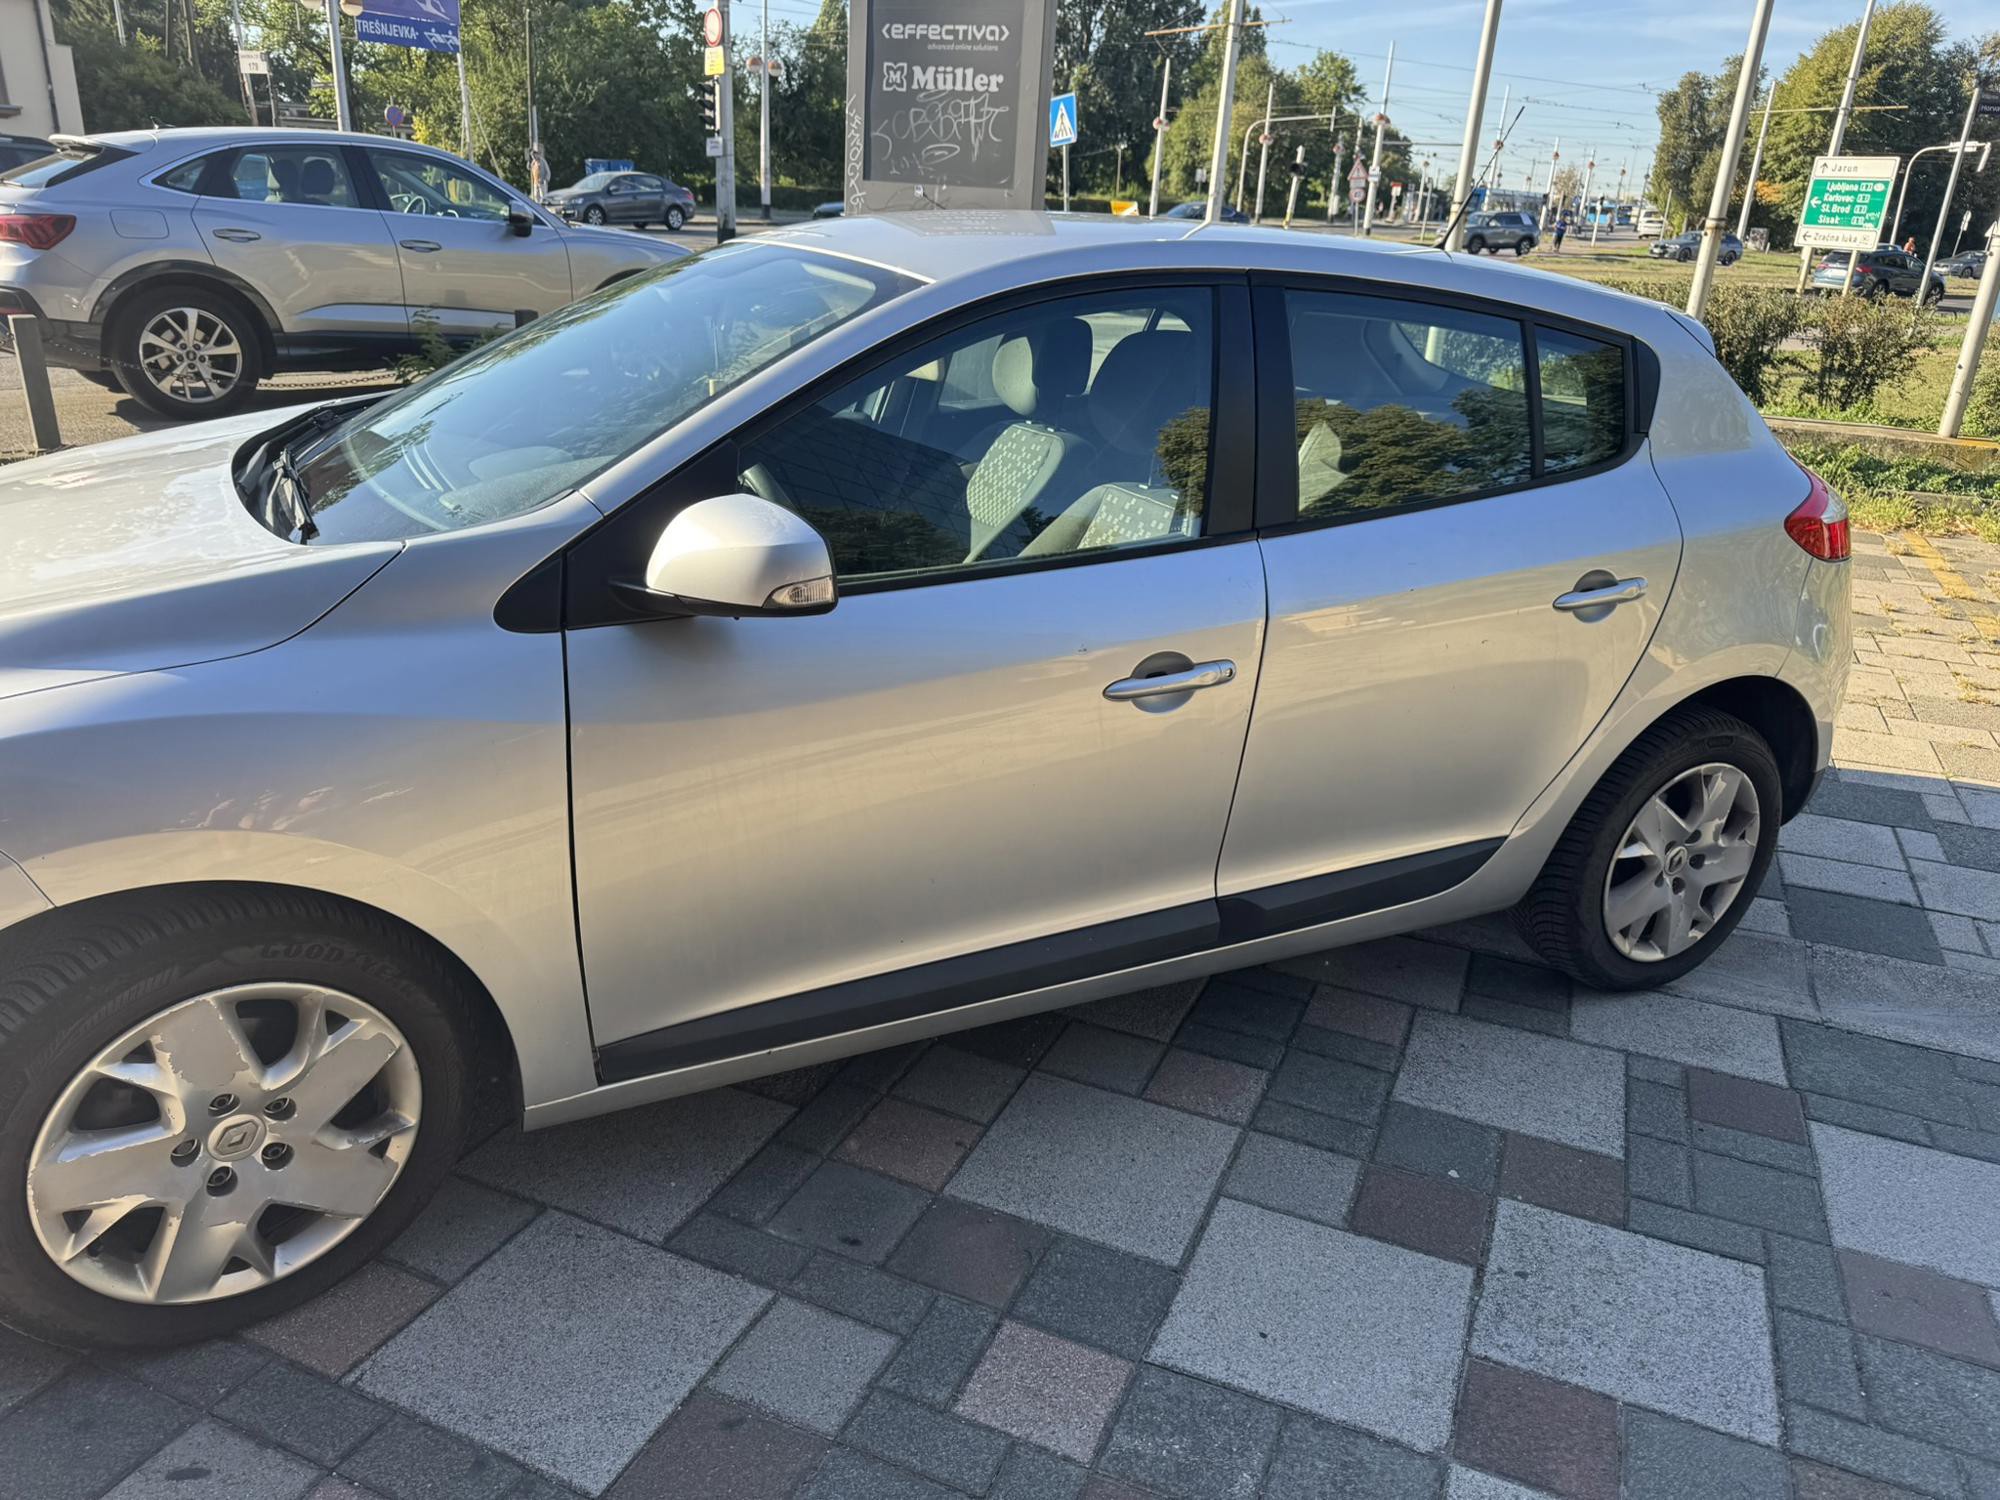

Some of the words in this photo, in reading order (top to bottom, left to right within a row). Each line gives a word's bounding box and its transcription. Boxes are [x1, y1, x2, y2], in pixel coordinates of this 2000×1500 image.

[911, 65, 1004, 92] Müller
[1831, 163, 1859, 173] Jarun
[1826, 182, 1859, 193] Ljubljana
[1823, 193, 1855, 202] Karlovac
[1831, 204, 1851, 214] Brod
[1817, 214, 1841, 224] Sisak
[1841, 233, 1858, 243] luka
